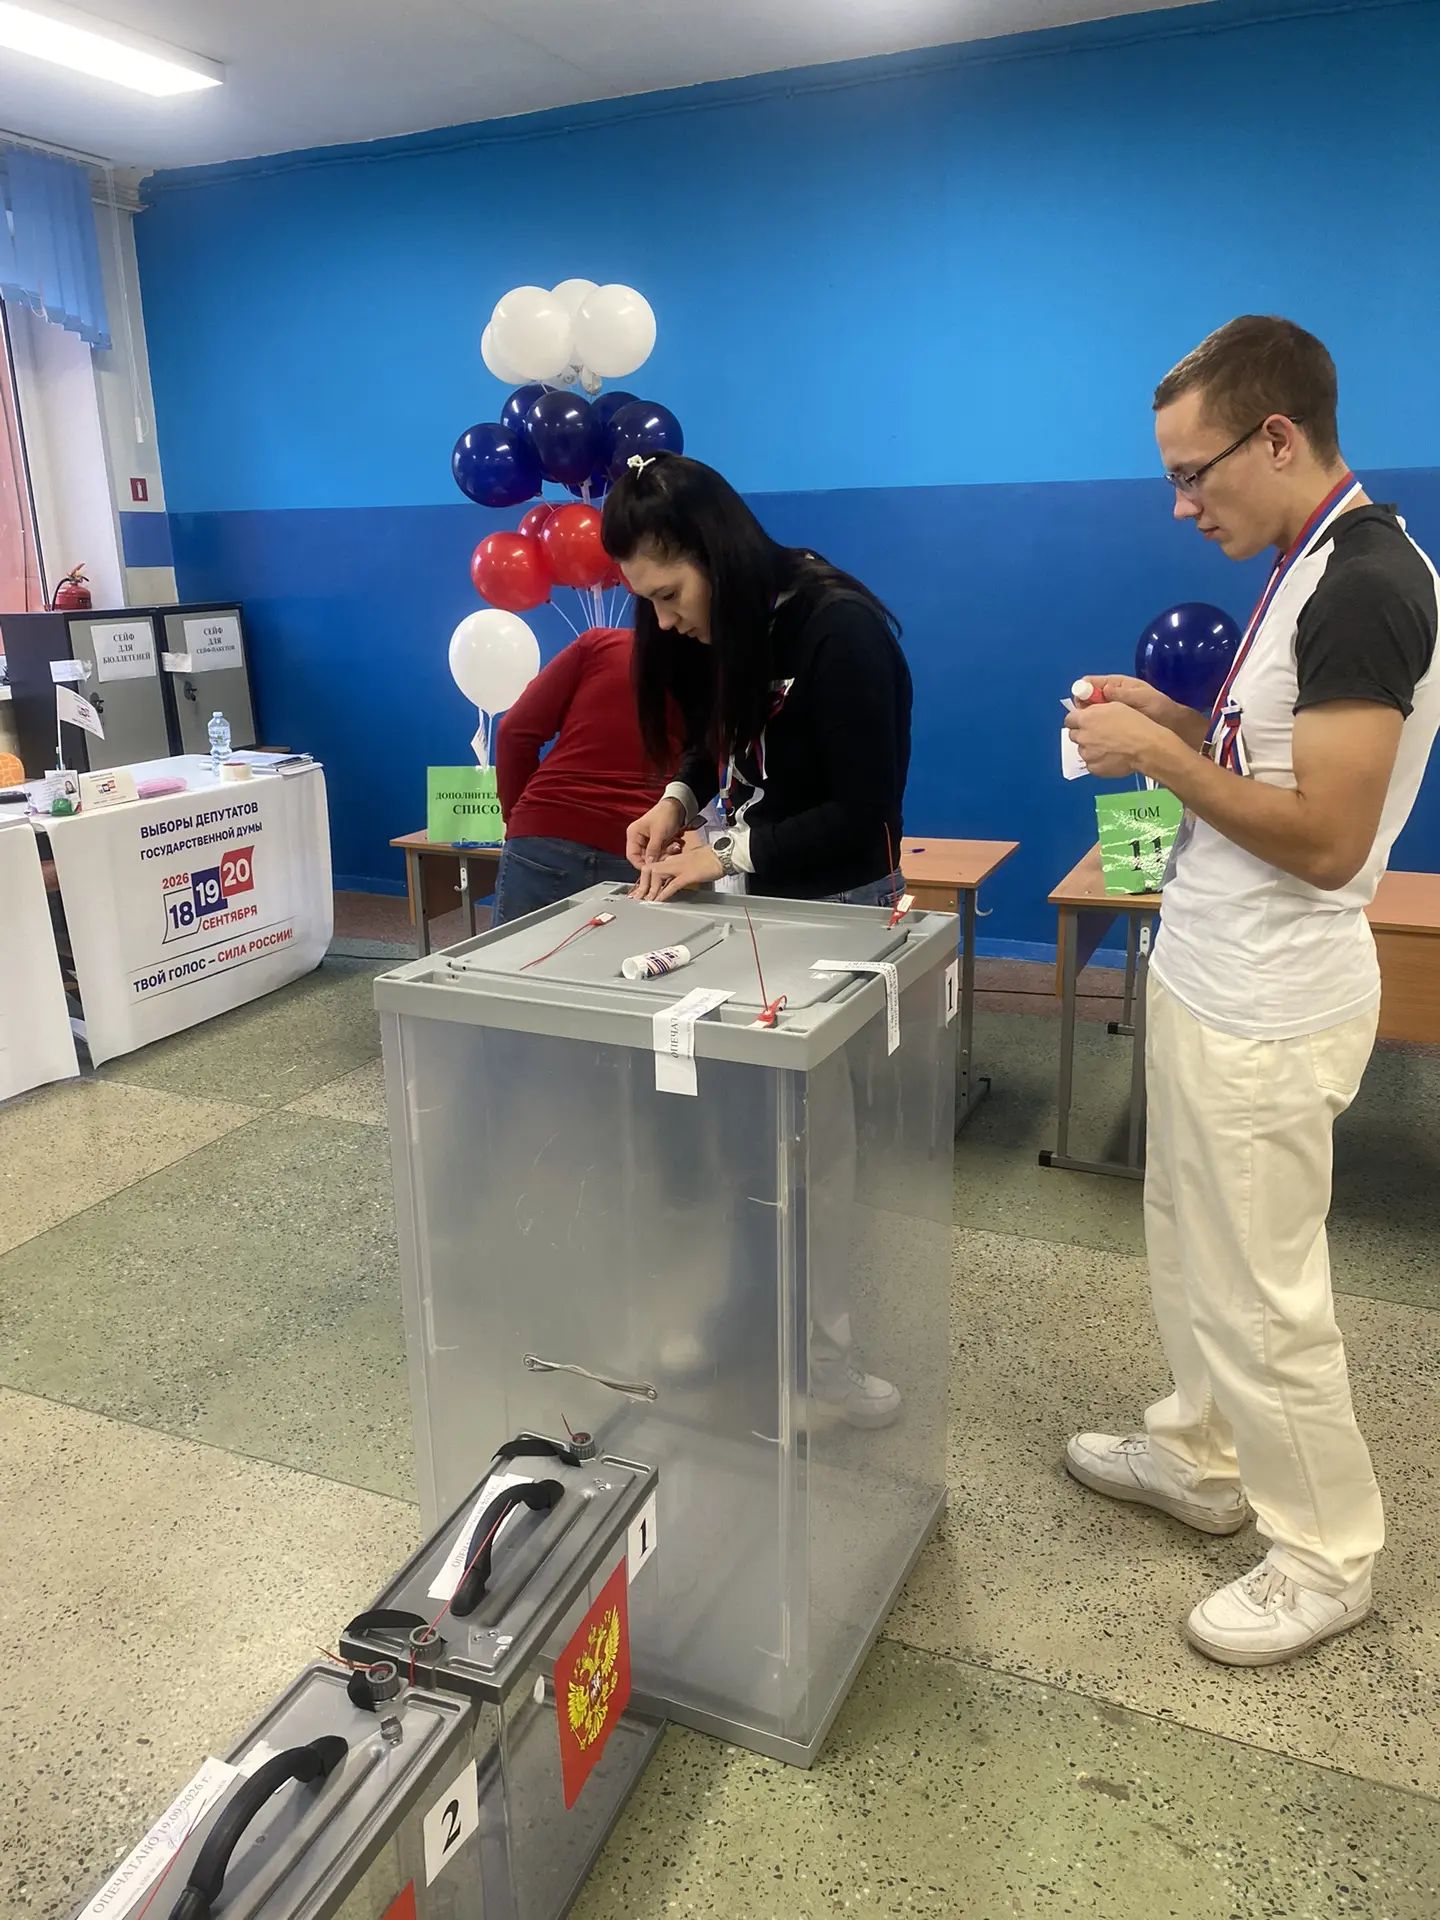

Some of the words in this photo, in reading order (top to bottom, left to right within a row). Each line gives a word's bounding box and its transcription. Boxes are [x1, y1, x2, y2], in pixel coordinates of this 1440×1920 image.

[113, 632, 135, 642] СЕЙФ
[203, 626, 224, 636] СЕЙФ
[207, 637, 222, 646] ДЛЯ
[103, 652, 151, 664] БЮЛЛЕТЕНЕЙ
[118, 644, 133, 653] ДЛЯ
[140, 816, 193, 839] ВЫБОРЫ
[195, 802, 258, 828] ДЕПУТАТОВ
[453, 804, 500, 815] СПИСО
[1129, 806, 1160, 821] ДОМ
[140, 826, 235, 860] ГОСУДАРСТВЕННОЙ
[236, 821, 263, 838] ДУМЫ
[162, 872, 190, 890] 2026
[169, 901, 194, 929] 18
[195, 878, 220, 907] 19
[222, 858, 250, 888] 20
[202, 904, 258, 931] СЕНТЯБРЯ
[133, 969, 167, 993] ТВОЙ
[169, 958, 206, 981] ГОЛОС
[217, 943, 247, 963] СИЛА
[249, 928, 293, 952] РОССИИ!
[947, 977, 953, 1012] 1
[639, 1518, 648, 1559] 1
[441, 1799, 461, 1855] 2
[92, 1836, 160, 1914] ОПЕЧАТАНО
